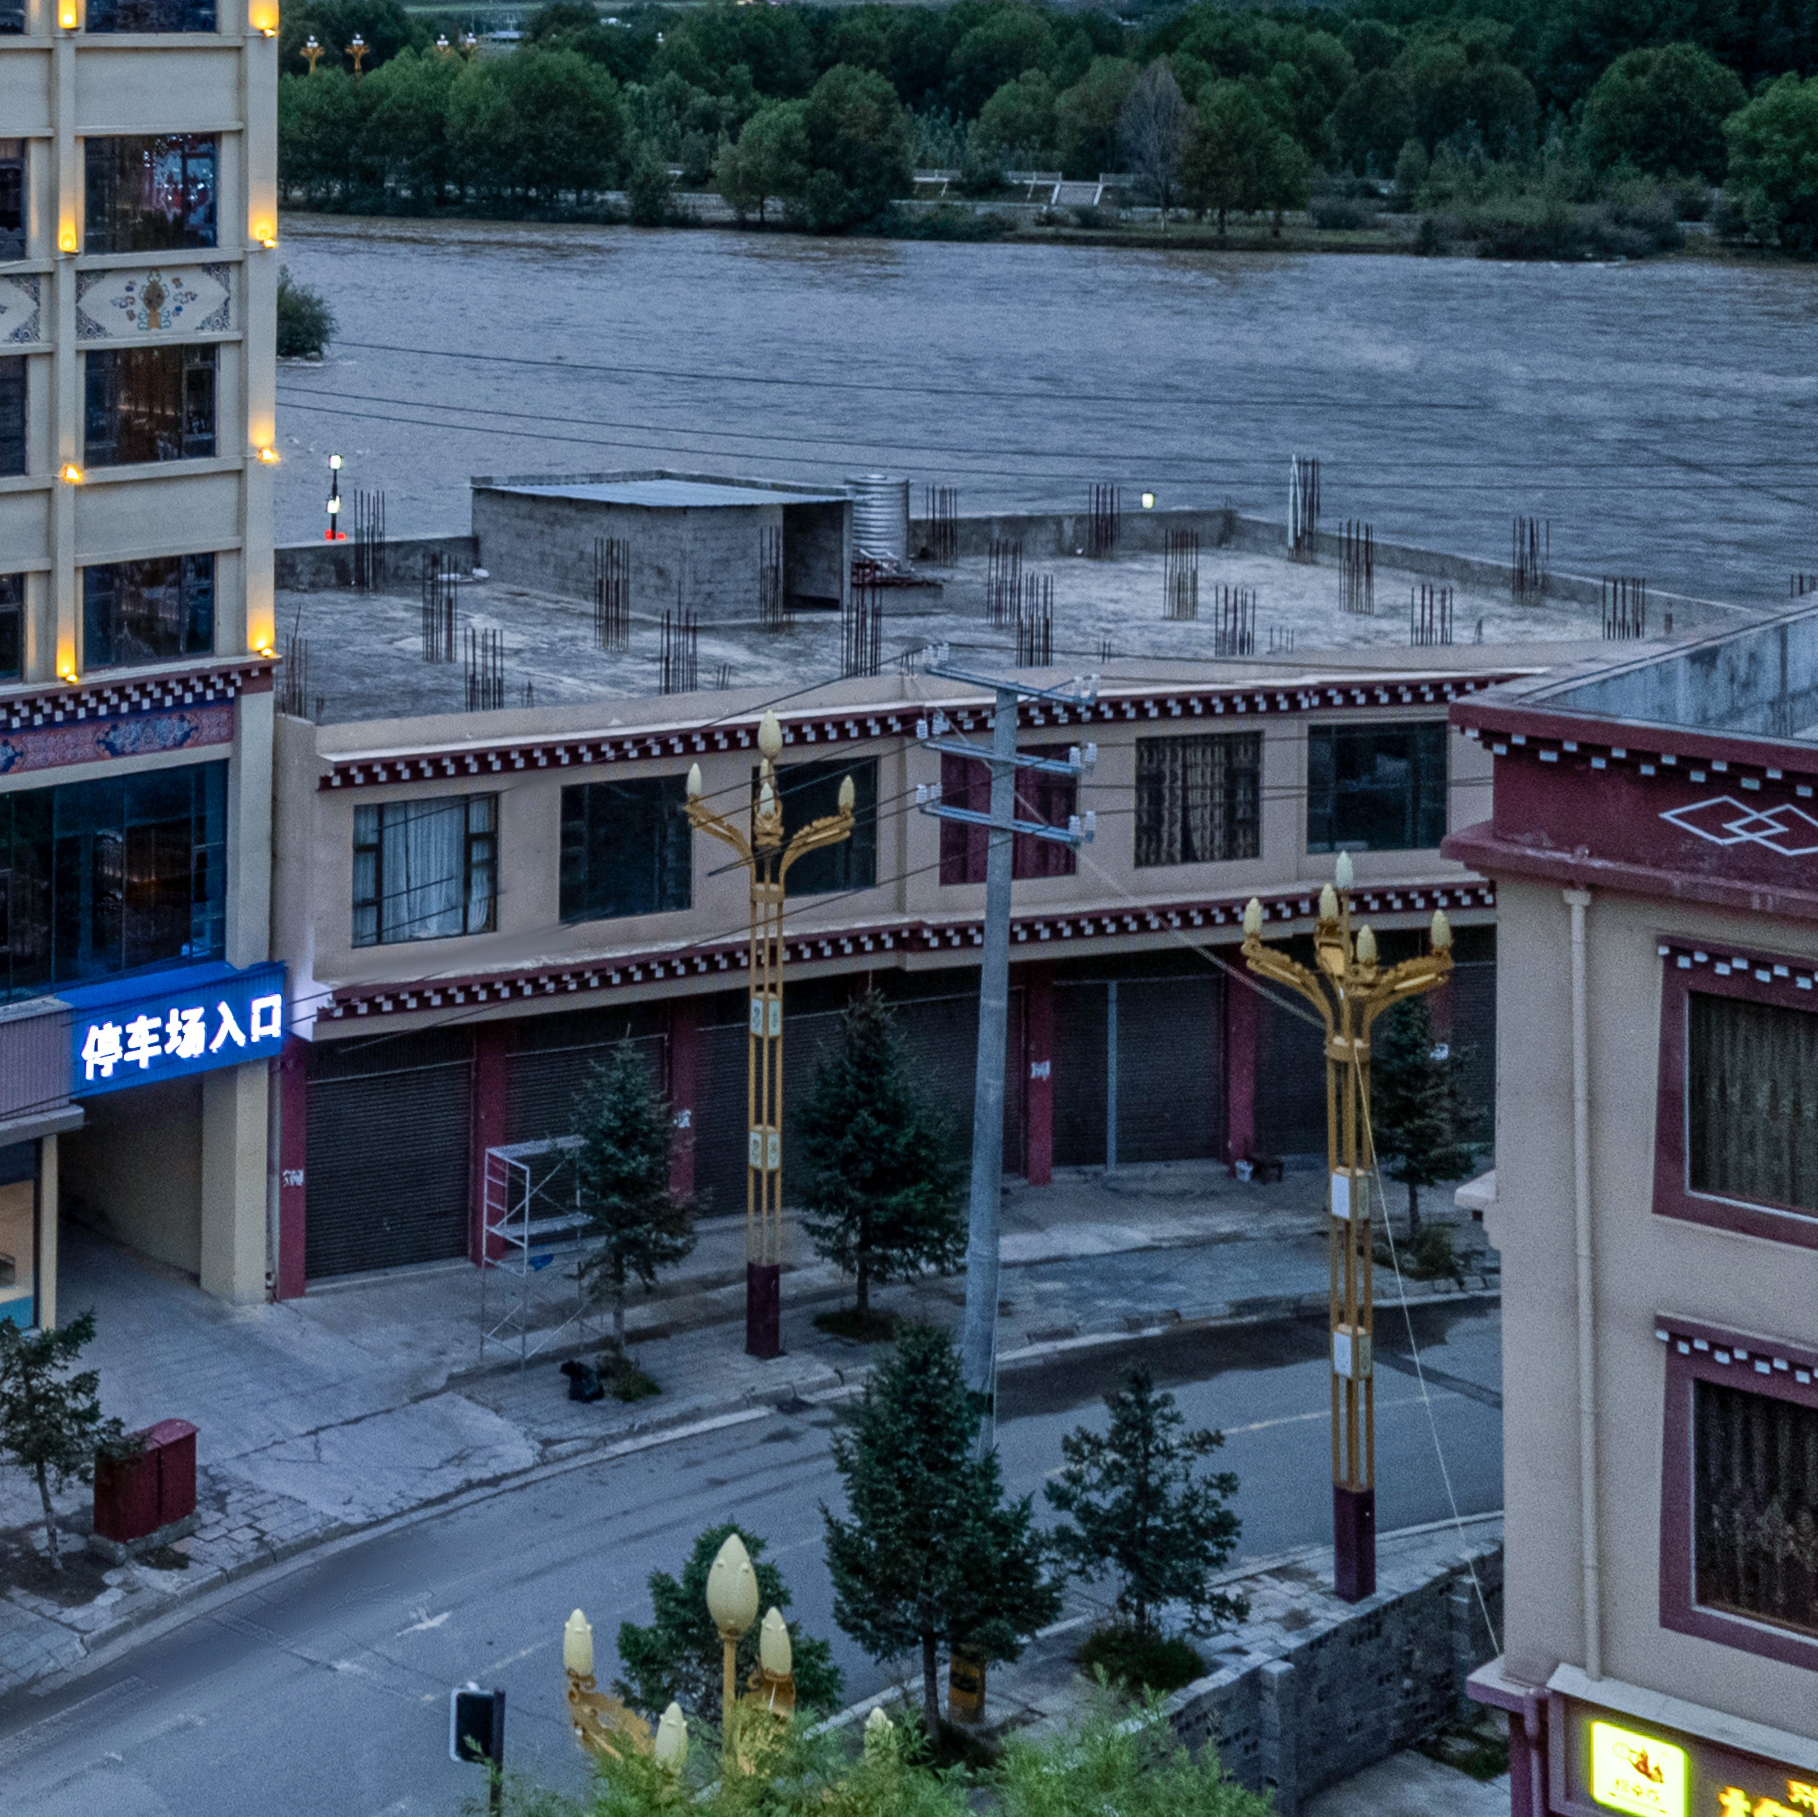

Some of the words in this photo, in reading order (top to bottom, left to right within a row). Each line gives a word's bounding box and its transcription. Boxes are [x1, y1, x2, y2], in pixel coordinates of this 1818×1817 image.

[81, 993, 282, 1080] 停车场入口
